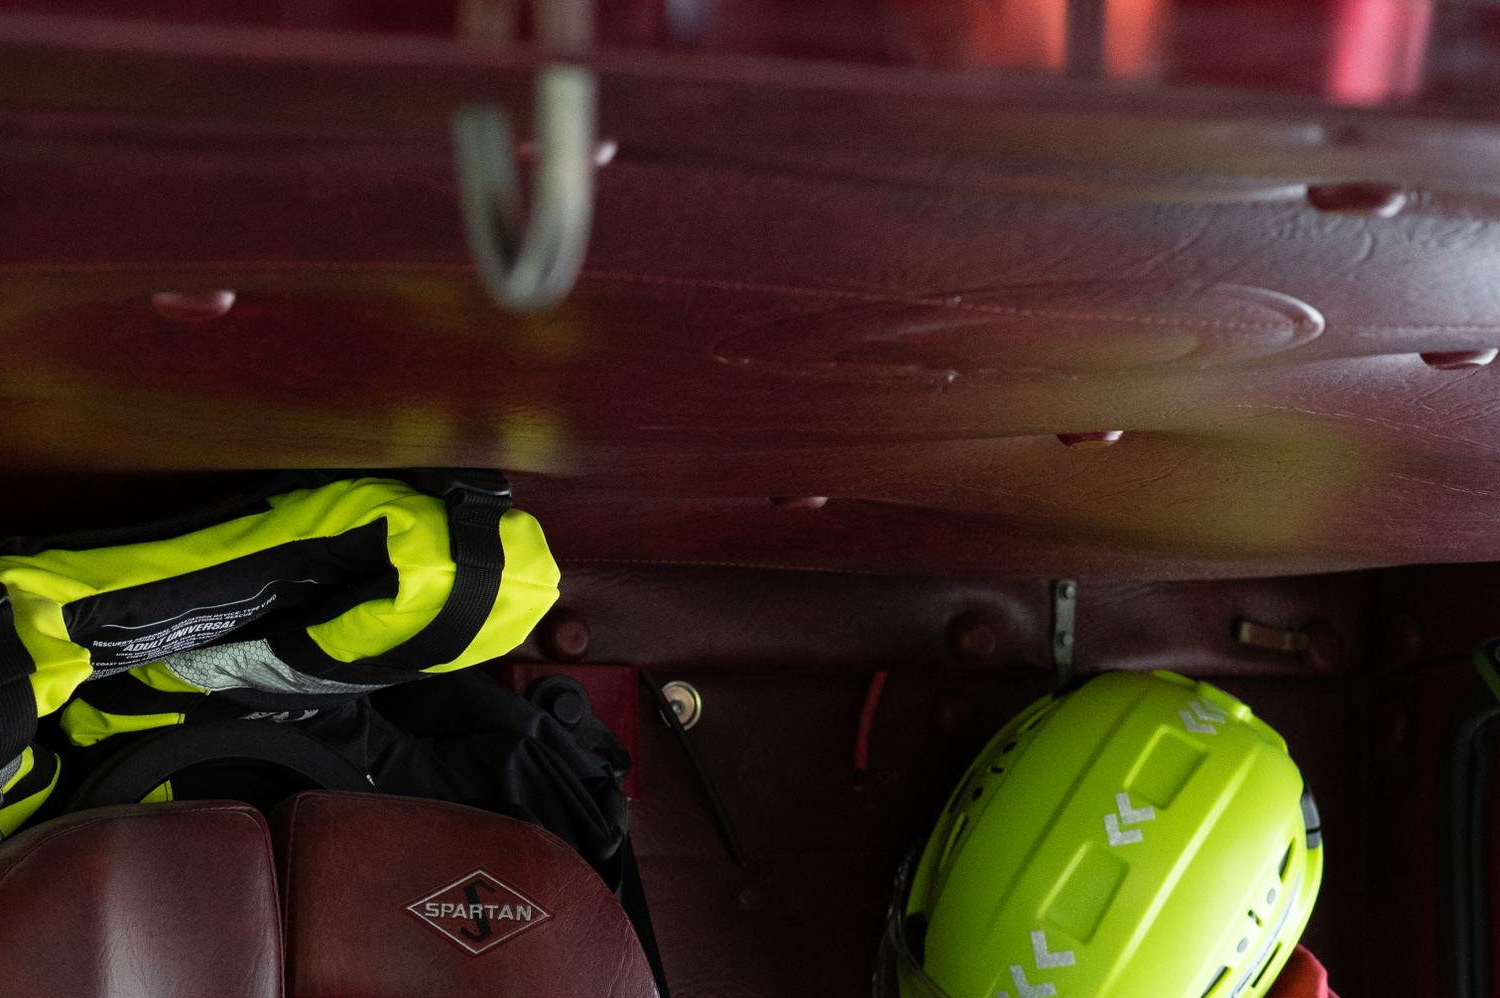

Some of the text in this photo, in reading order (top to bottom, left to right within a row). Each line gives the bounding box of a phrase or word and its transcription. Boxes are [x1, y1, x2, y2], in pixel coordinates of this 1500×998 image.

[122, 637, 167, 652] ADULT
[165, 619, 237, 643] UNIVERSAL
[424, 902, 532, 922] SPARTAN
